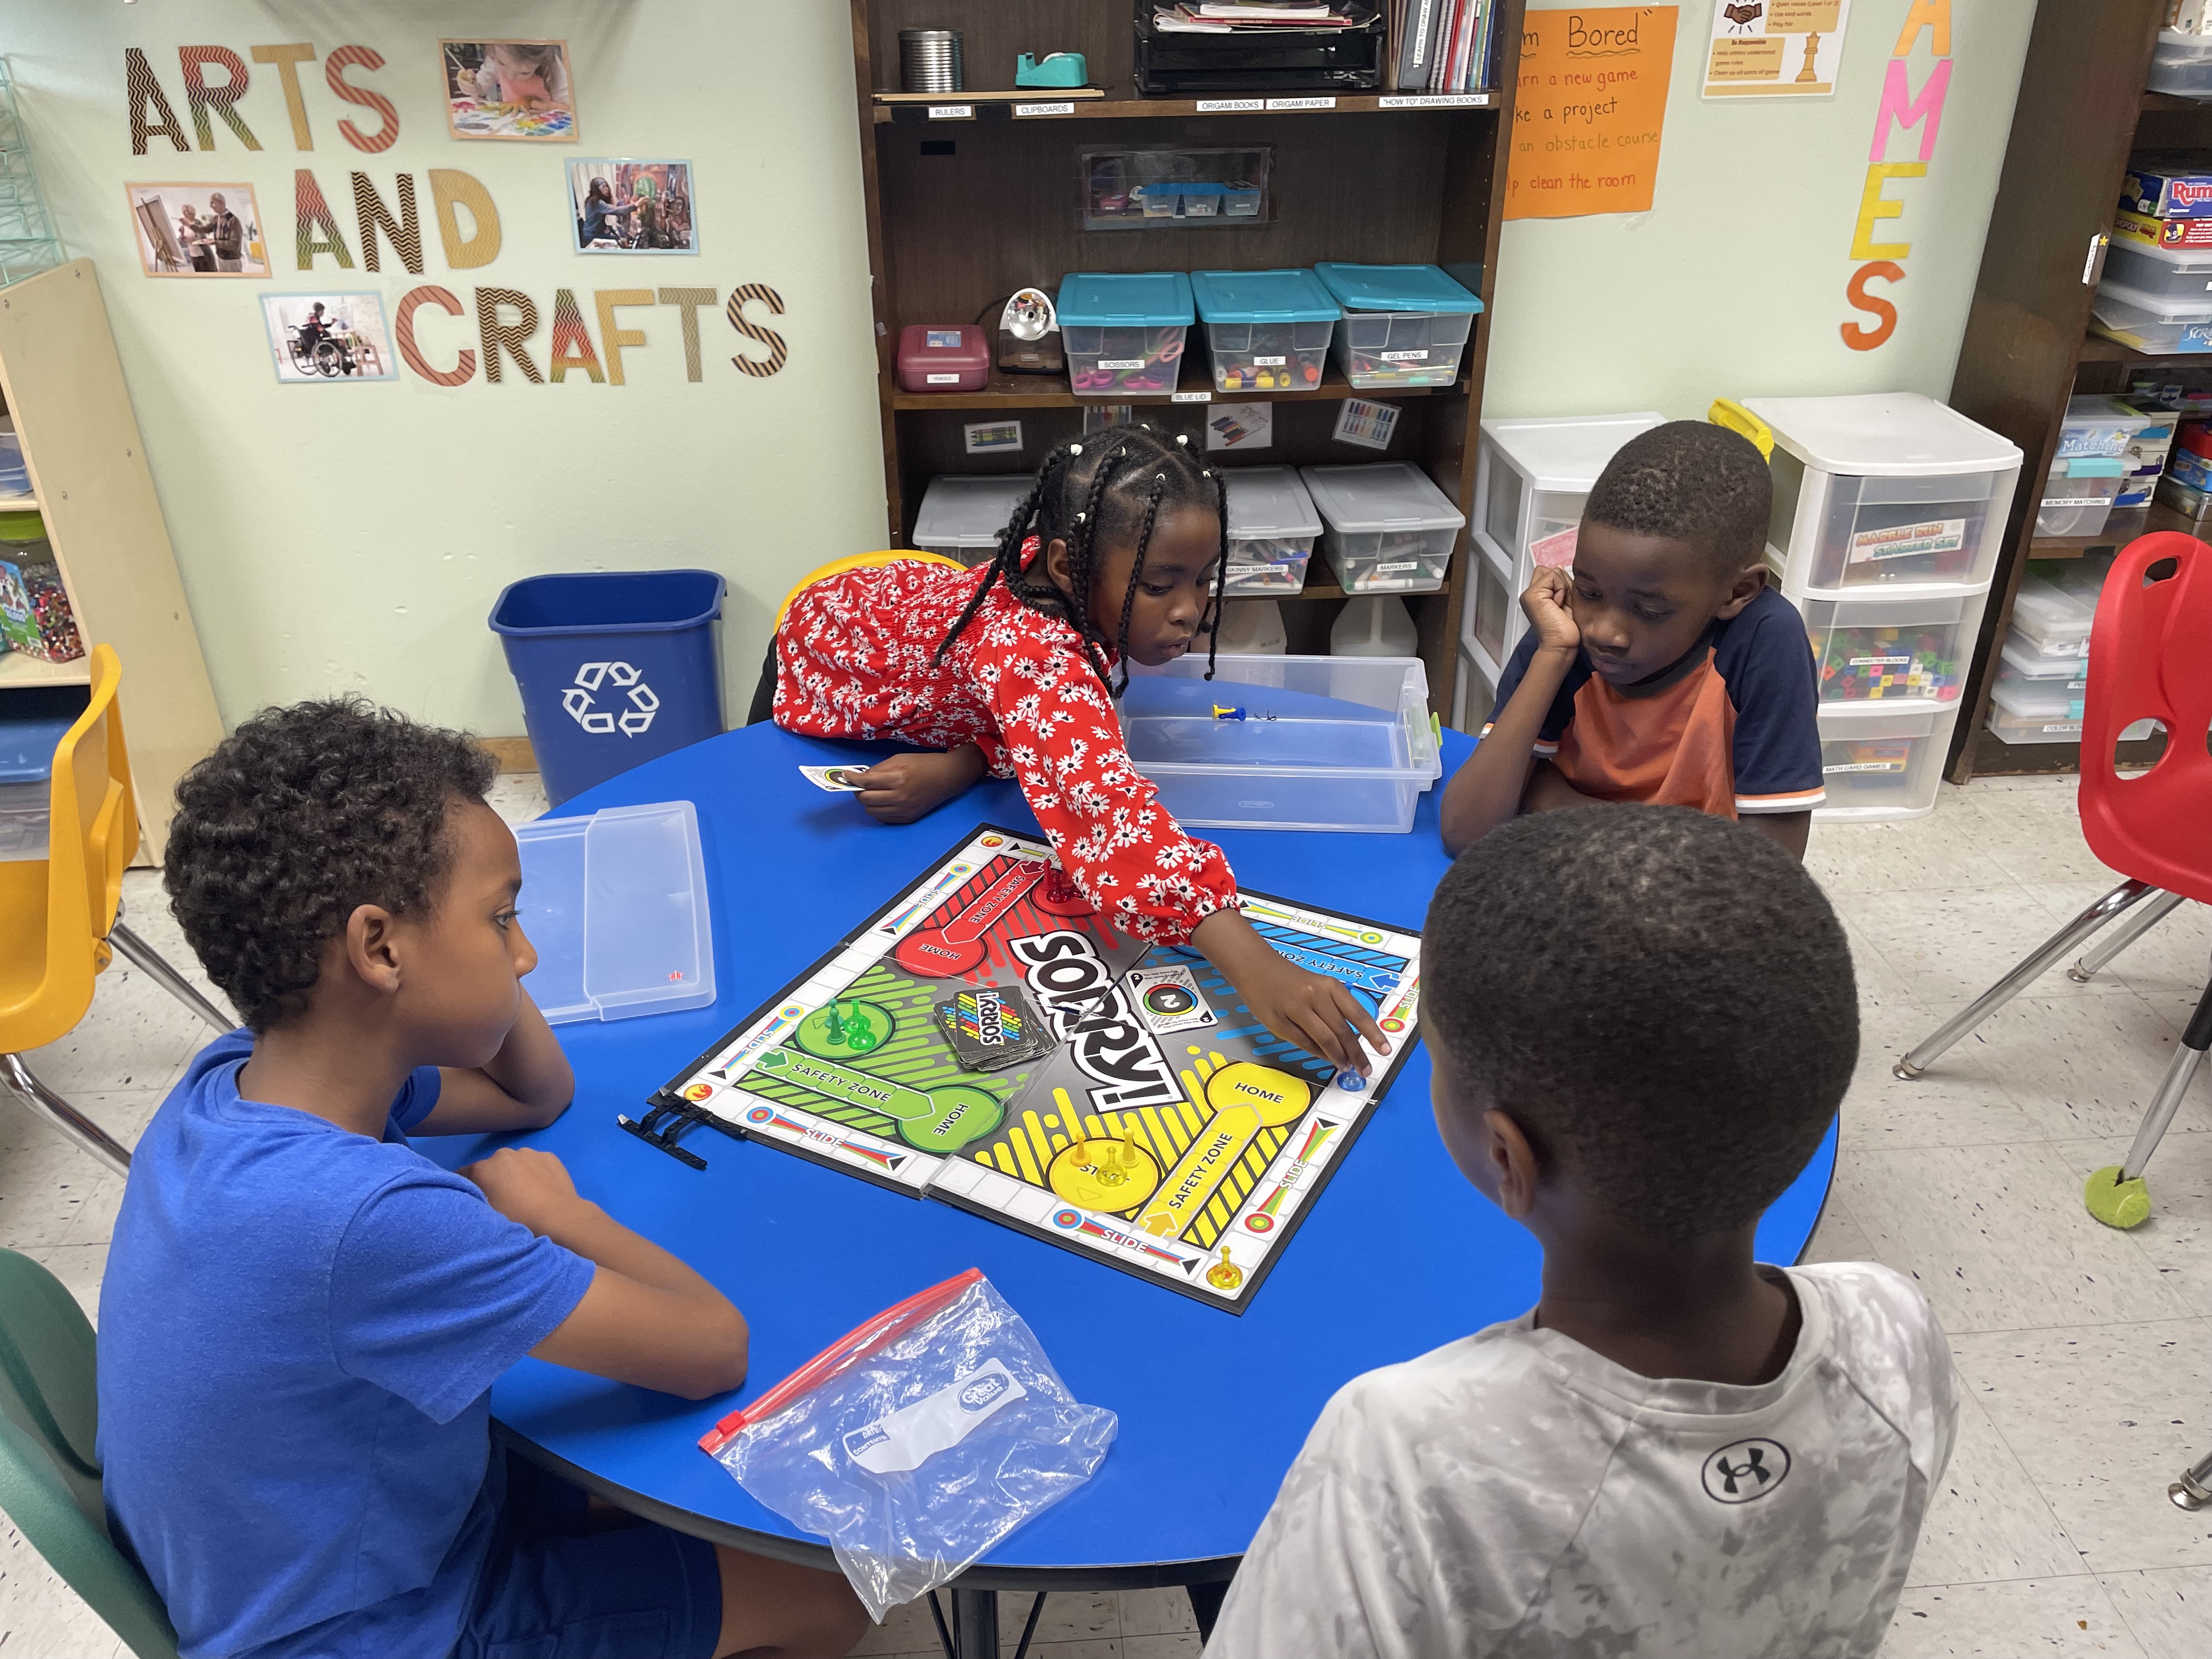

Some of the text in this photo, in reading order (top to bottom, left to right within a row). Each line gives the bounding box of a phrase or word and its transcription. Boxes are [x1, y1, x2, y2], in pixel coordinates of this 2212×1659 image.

[1419, 28, 1425, 37] TO
[1415, 38, 1424, 60] LEARN
[1549, 76, 1557, 86] a
[1564, 72, 1592, 86] new
[1597, 70, 1638, 92] game
[125, 44, 400, 156] ARTS
[1021, 105, 1068, 114] CLIPBOARDS
[1543, 109, 1554, 120] a
[1563, 97, 1618, 125] project
[1519, 132, 1659, 152] an obstacle course
[1530, 175, 1562, 190] clean
[1569, 173, 1591, 190] the
[1598, 174, 1635, 188] room
[295, 168, 501, 275] AND
[394, 283, 788, 387] CRAFTS
[2061, 439, 2125, 455] Matching
[1855, 523, 1943, 547] MARBLE RUN
[1873, 534, 1961, 558] STARTER SET
[915, 888, 941, 907] SLIDE
[969, 876, 1025, 923] SAFETY ZONE
[1290, 915, 1328, 930] SLIDE
[919, 943, 962, 961] HOME
[1308, 957, 1365, 979] SAFETY
[1160, 994, 1180, 1008] 2
[1399, 986, 1420, 1009] SLIDE
[975, 992, 1003, 1046] SORRY!
[1007, 929, 1188, 1114] SORRY!
[741, 1029, 775, 1054] SLIDE
[791, 1064, 893, 1103] SAFETY ZONE
[1233, 1081, 1285, 1104] HOME
[932, 1103, 970, 1137] HOME
[803, 1128, 845, 1148] SLIDE
[1169, 1131, 1234, 1209] SAFETY ZONE
[1278, 1158, 1310, 1191] SLIDE
[1099, 1228, 1149, 1254] SLIDE
[962, 1378, 1000, 1403] Great
[975, 1386, 1003, 1405] Value
